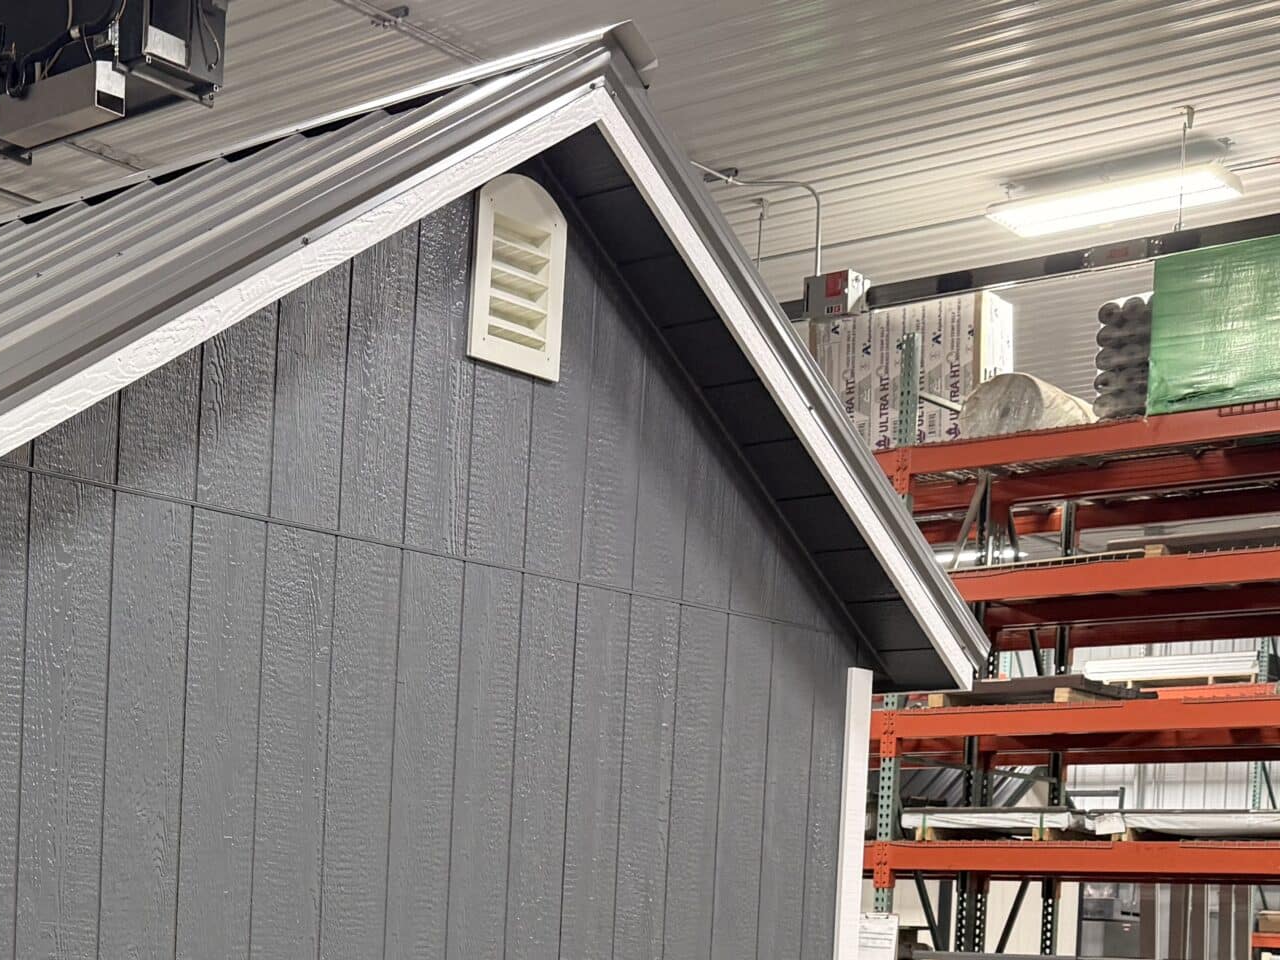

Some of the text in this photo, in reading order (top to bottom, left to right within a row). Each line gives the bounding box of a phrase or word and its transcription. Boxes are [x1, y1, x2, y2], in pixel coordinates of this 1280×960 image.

[879, 376, 890, 392] HT
[949, 362, 961, 379] HT
[879, 394, 889, 433] ULTRA
[949, 380, 960, 421] UTRA
